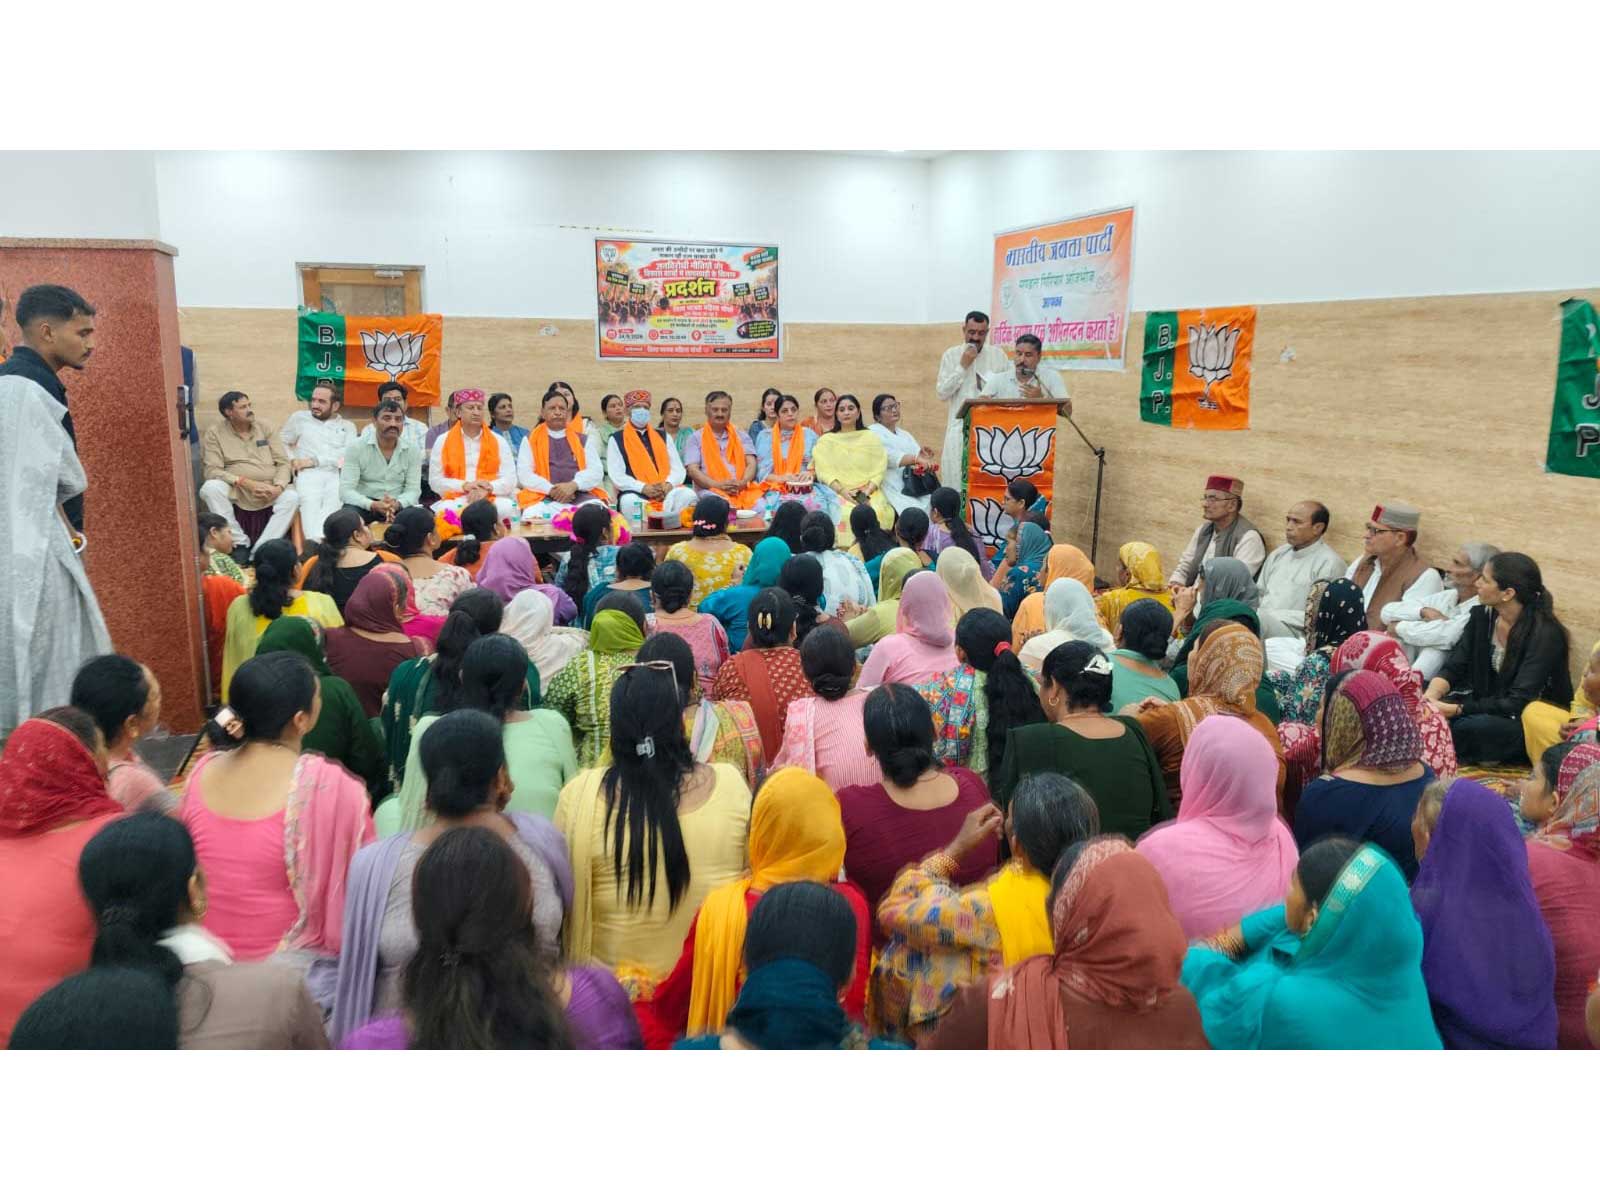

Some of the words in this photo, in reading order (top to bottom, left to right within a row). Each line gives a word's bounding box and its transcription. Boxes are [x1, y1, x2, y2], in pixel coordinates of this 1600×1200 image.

[1006, 240, 1045, 266] भारतीय
[1047, 237, 1083, 261] जनता
[1086, 224, 1114, 255] पार्टी
[664, 277, 717, 298] प्रदर्शन
[1048, 316, 1084, 343] अभिनन्दन
[1086, 320, 1108, 342] करता
